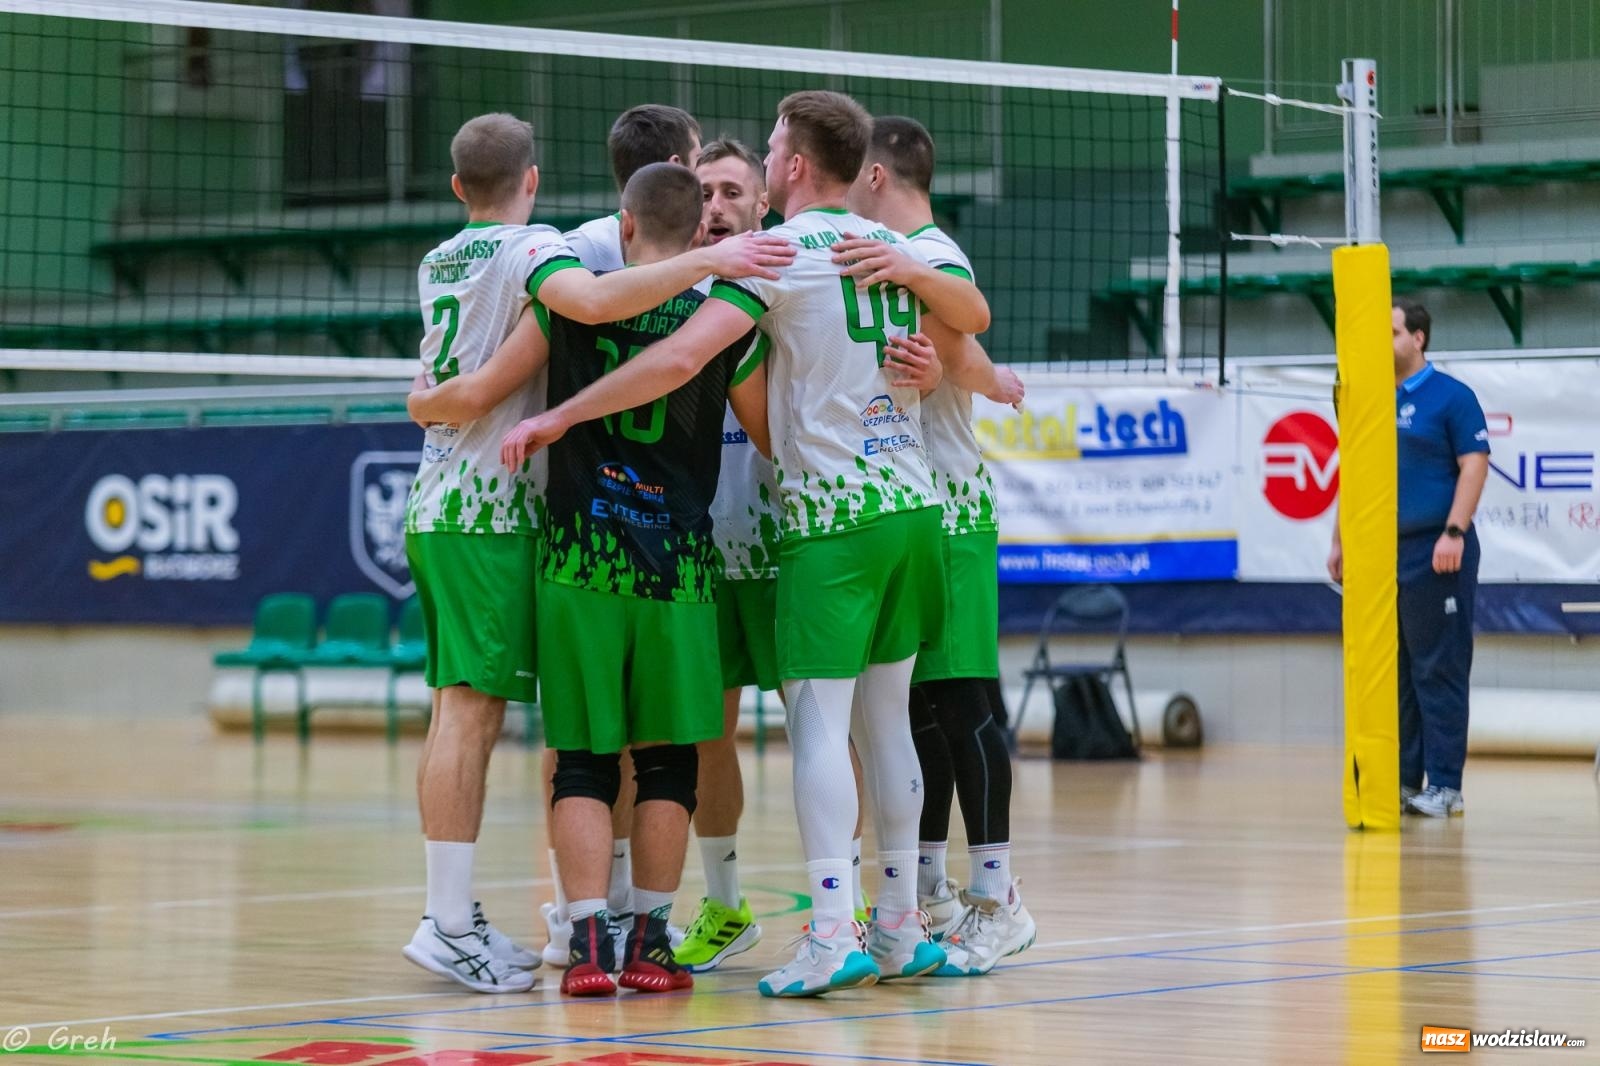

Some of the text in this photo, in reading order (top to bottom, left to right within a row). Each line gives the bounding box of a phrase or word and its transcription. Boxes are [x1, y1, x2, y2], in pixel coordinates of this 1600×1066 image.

[432, 295, 460, 386] 2
[85, 474, 240, 553] OSiR
[635, 482, 664, 494] MULTI
